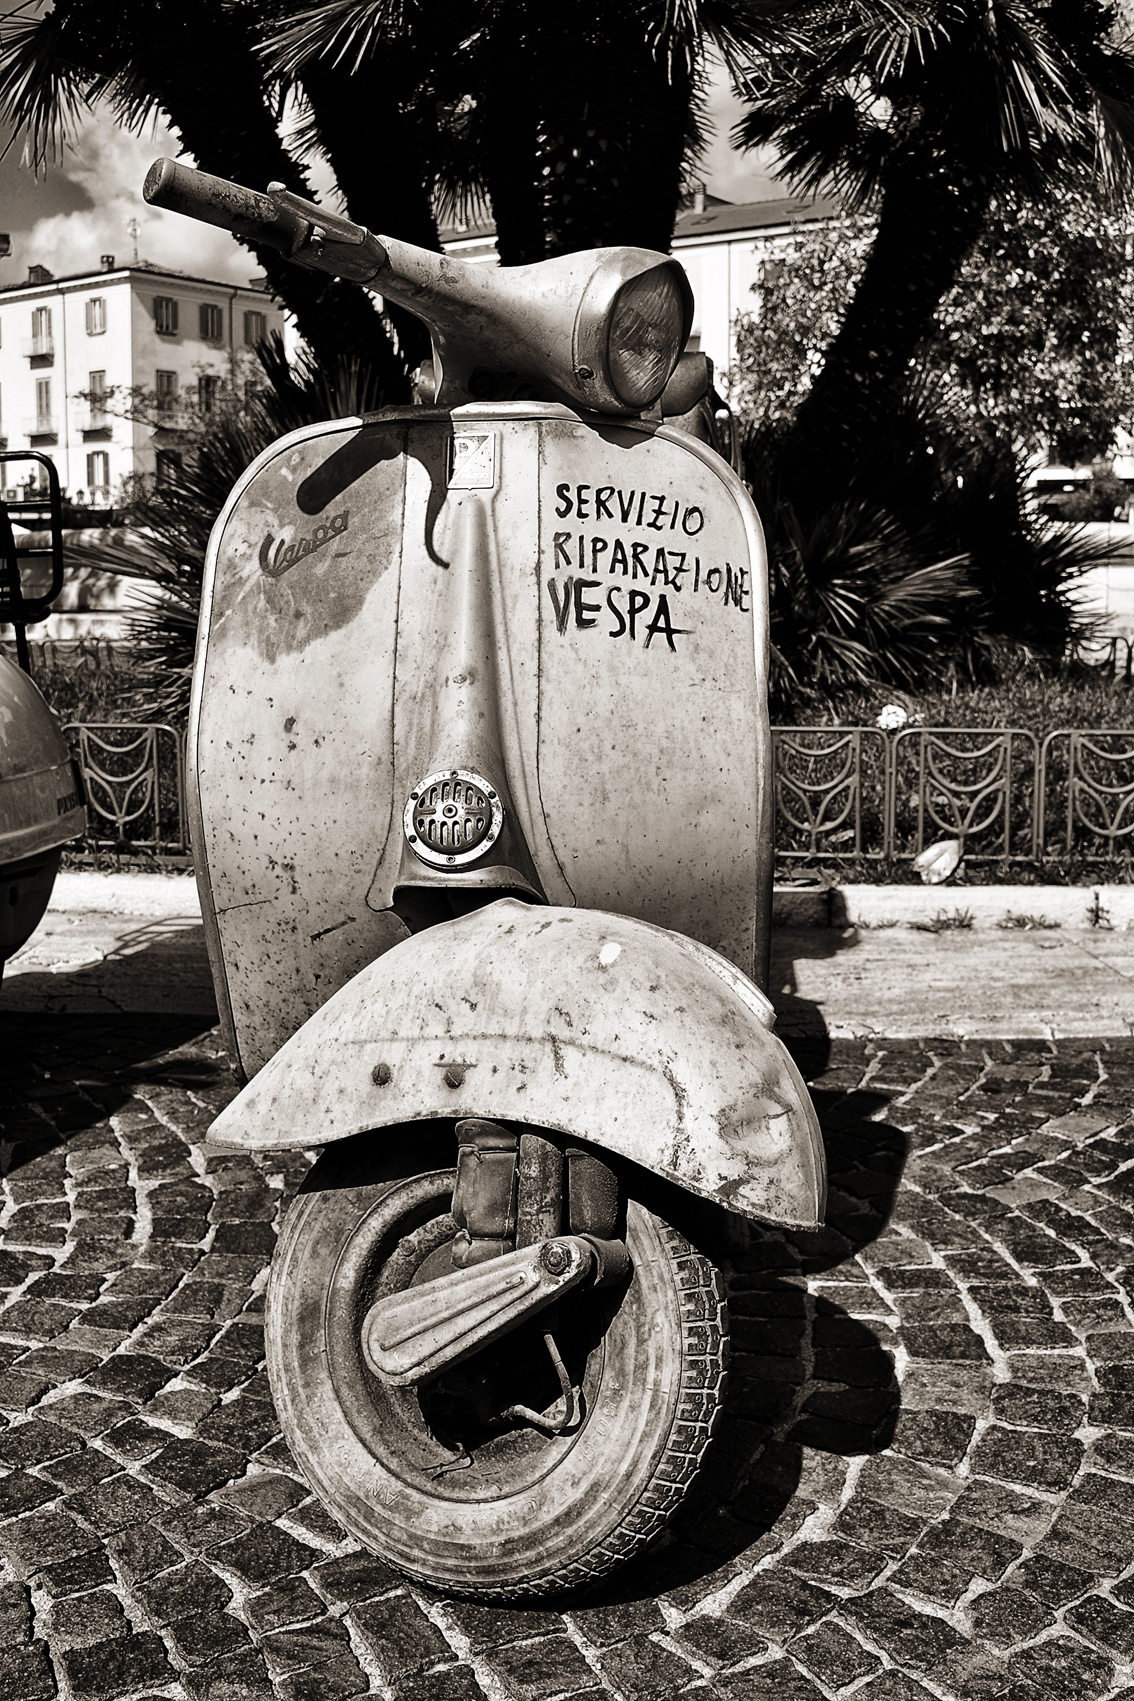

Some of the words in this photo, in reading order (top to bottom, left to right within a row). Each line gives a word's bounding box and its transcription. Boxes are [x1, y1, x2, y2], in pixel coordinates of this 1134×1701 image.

[259, 510, 350, 578] Vespa
[554, 483, 705, 536] SERVIZIO
[552, 532, 750, 612] RIPARAZIONE
[547, 576, 696, 653] VESPA
